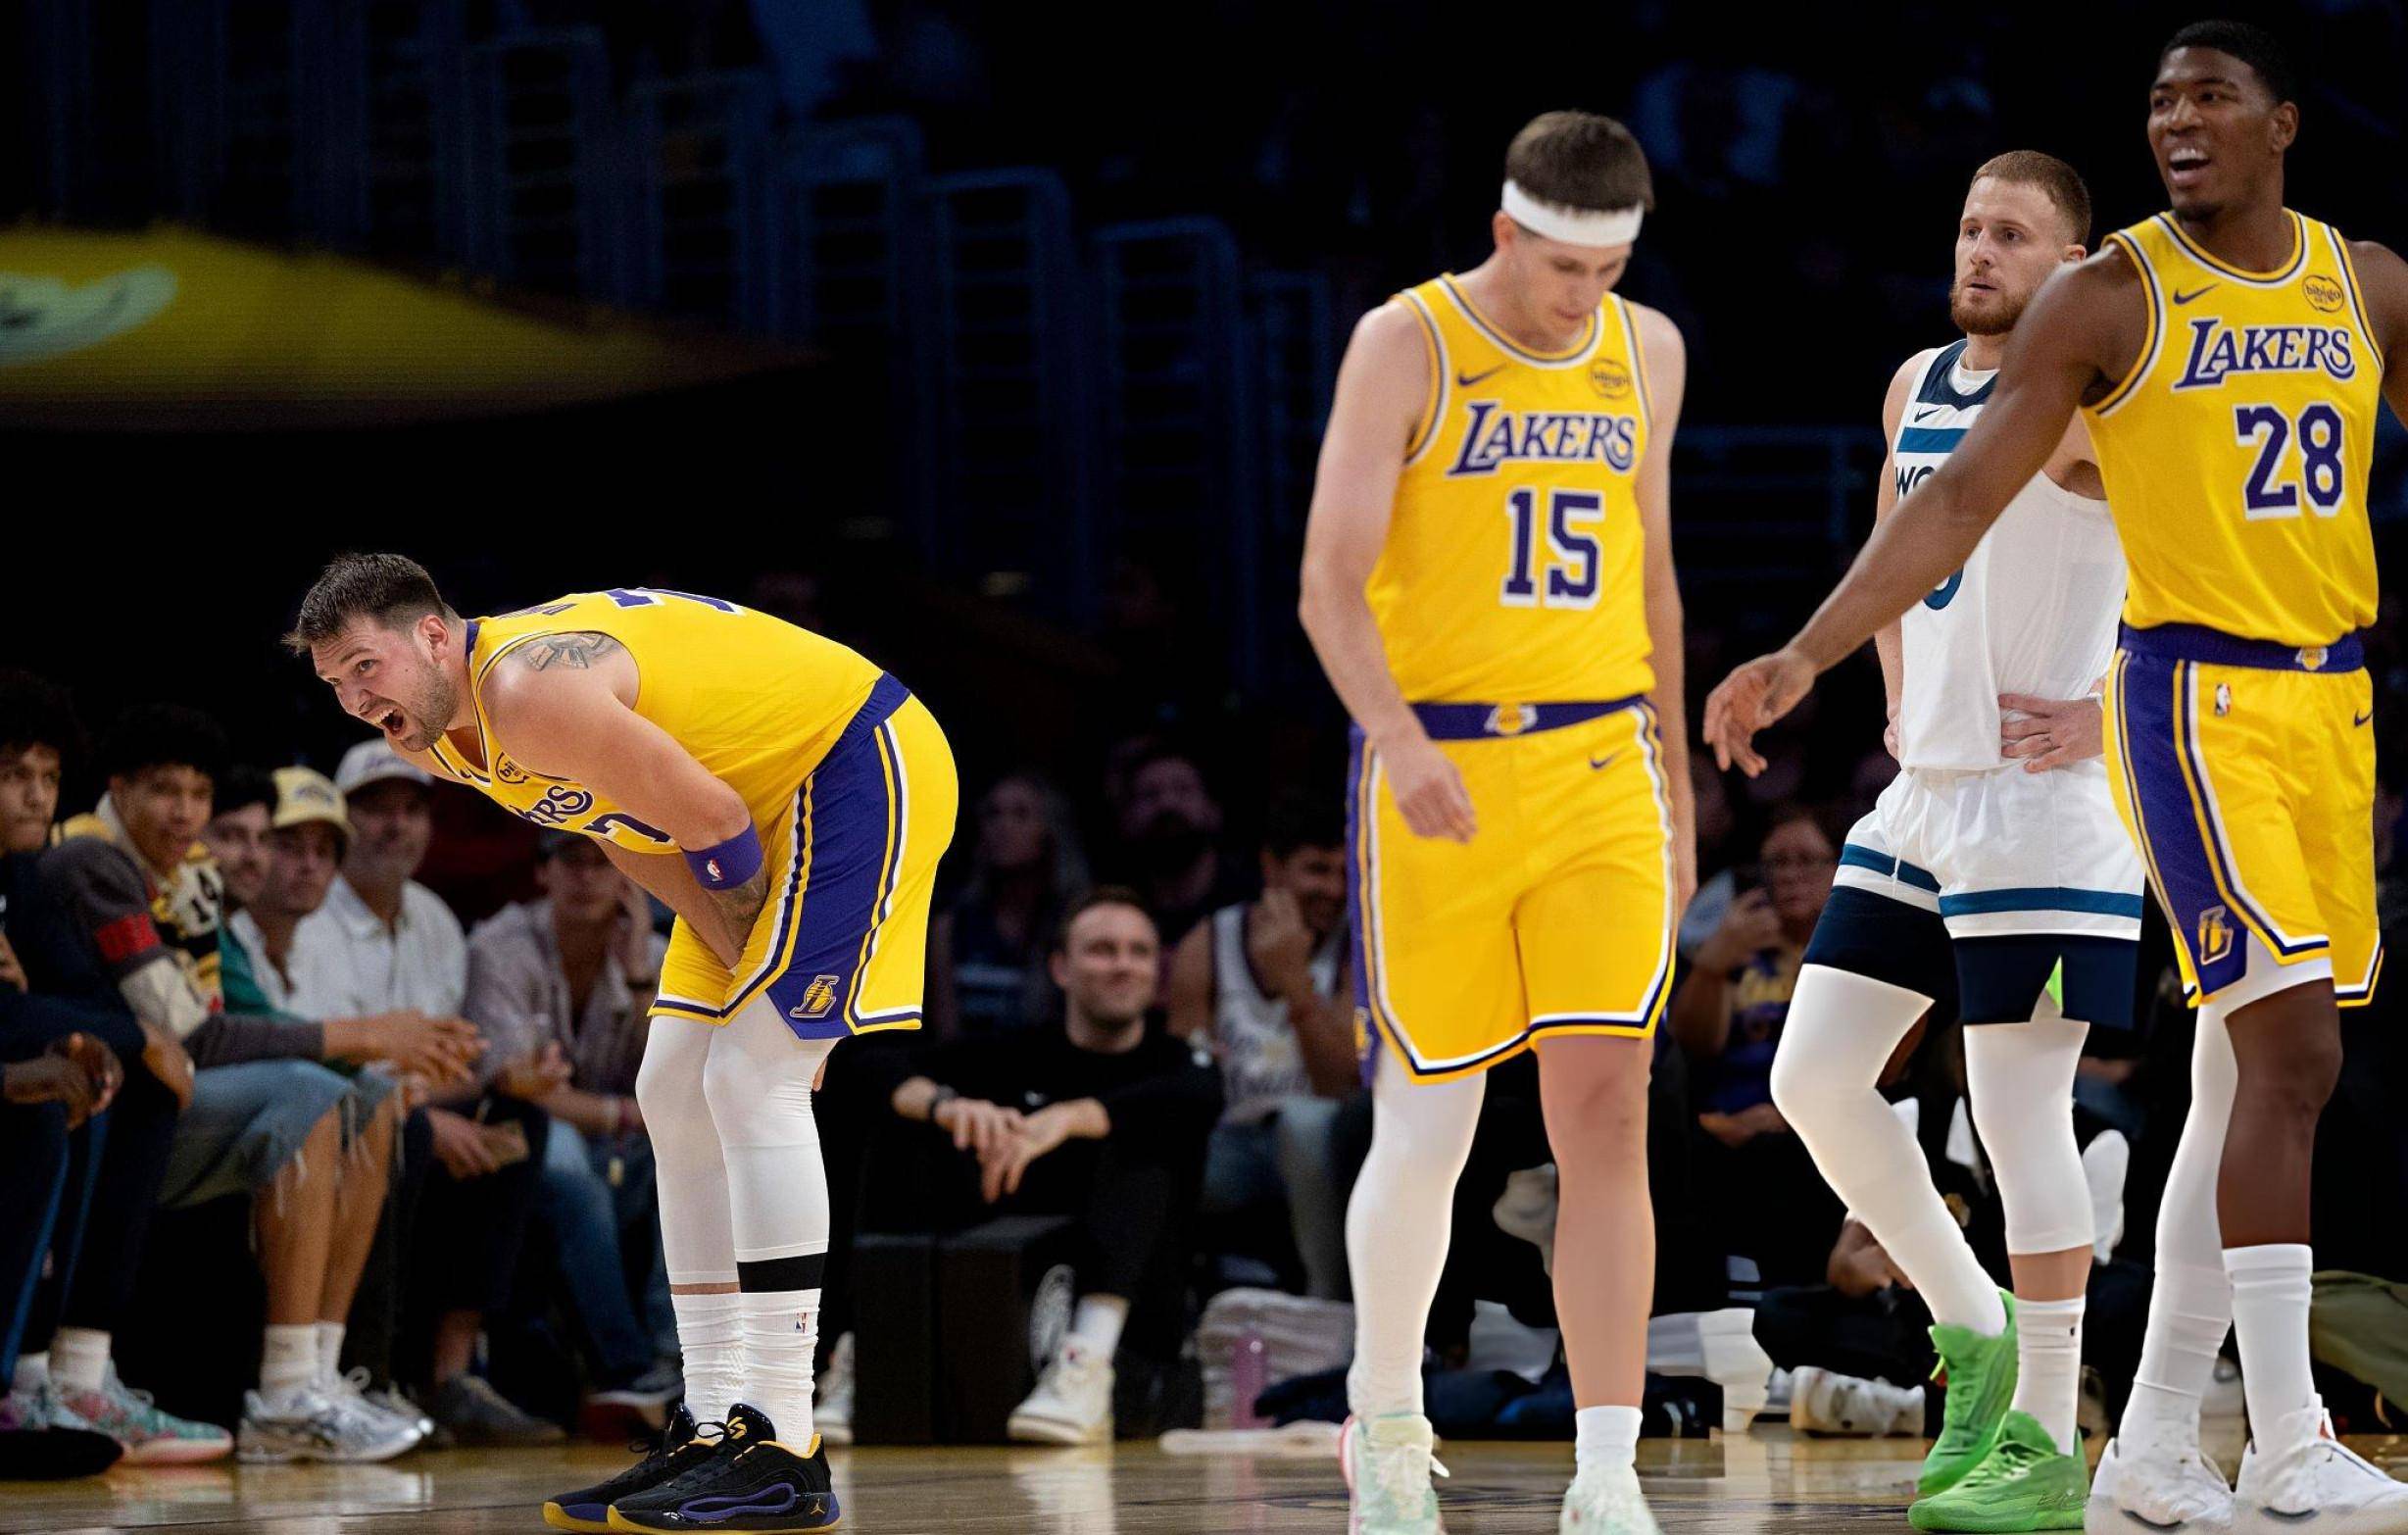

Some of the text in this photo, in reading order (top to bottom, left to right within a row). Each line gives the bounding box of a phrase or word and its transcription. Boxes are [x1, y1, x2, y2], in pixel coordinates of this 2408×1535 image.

[2172, 318, 2356, 391] LAKERS
[1446, 401, 1637, 475] LAKERS
[2233, 401, 2343, 520] 28
[1501, 488, 1603, 606] 15
